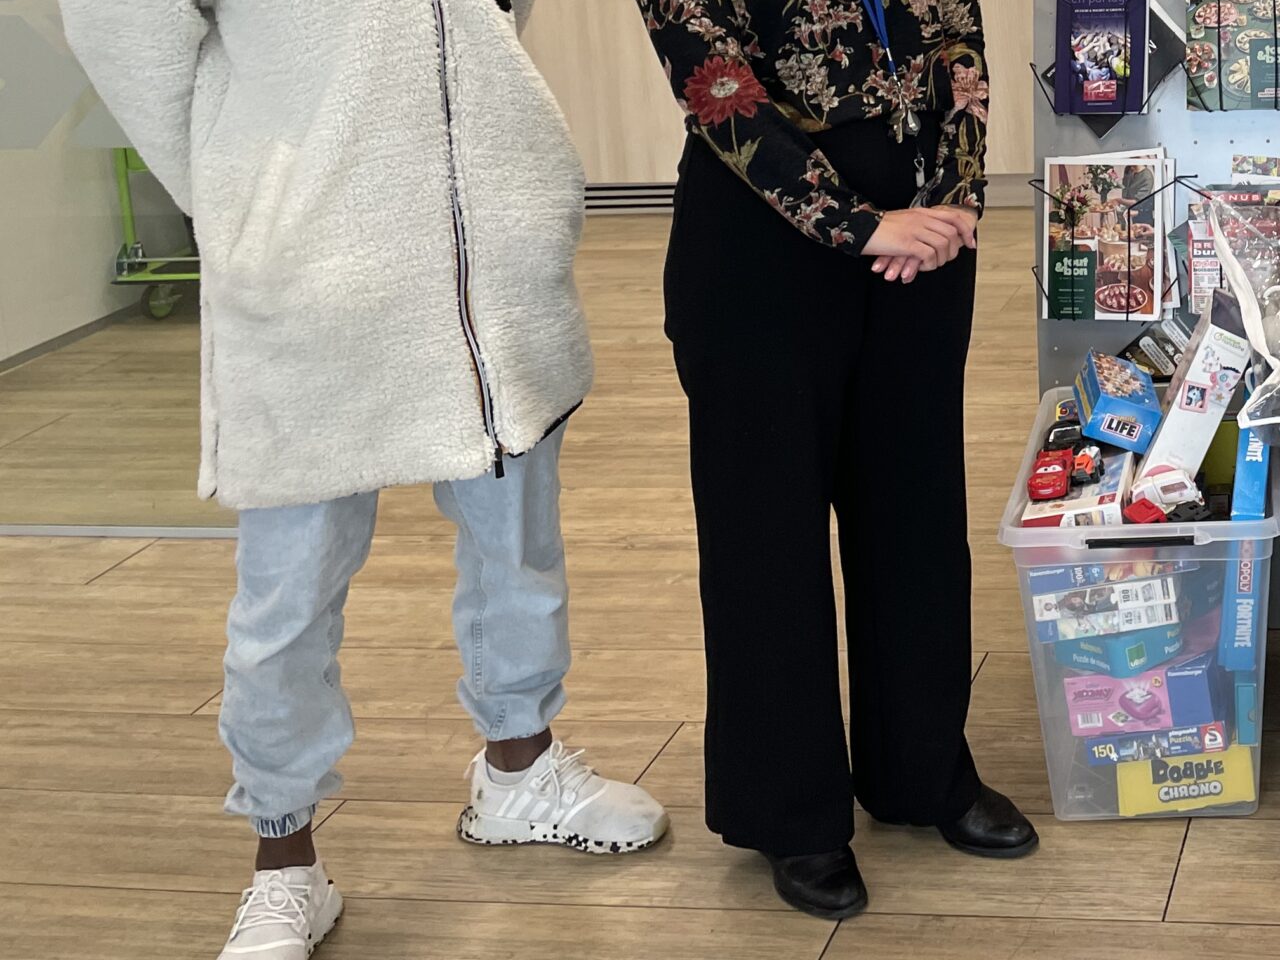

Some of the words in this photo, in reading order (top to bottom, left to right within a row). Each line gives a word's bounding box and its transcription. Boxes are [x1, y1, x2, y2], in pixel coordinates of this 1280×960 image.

[1063, 257, 1088, 267] tout
[1064, 267, 1088, 276] bon
[1106, 418, 1137, 437] LIFE
[1235, 598, 1254, 647] FORTNITE
[1092, 743, 1115, 758] 150
[1159, 781, 1223, 802] CHRONO
